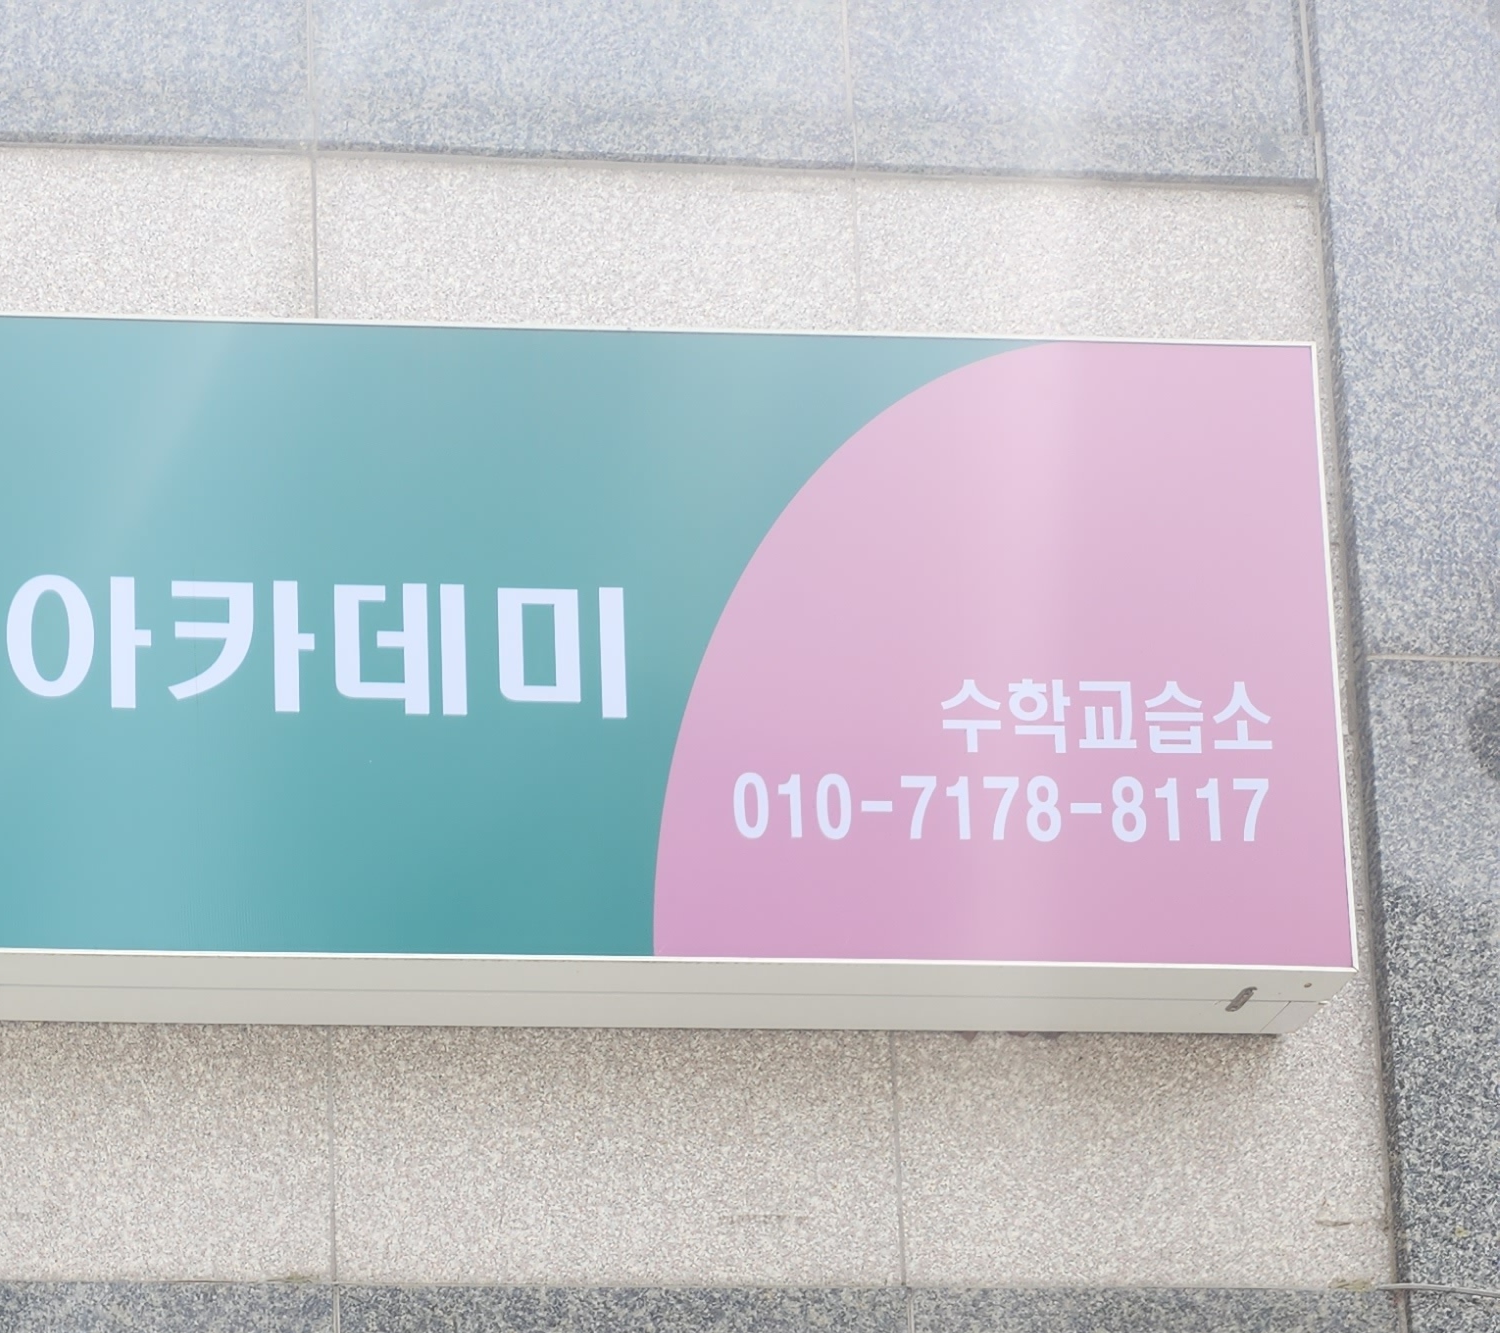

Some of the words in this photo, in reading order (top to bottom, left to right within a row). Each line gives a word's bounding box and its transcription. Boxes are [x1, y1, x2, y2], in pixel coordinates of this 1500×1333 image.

[5, 573, 628, 719] 아카데미
[939, 677, 1275, 756] 수학교습소
[731, 771, 1271, 842] 010-7178-8117
